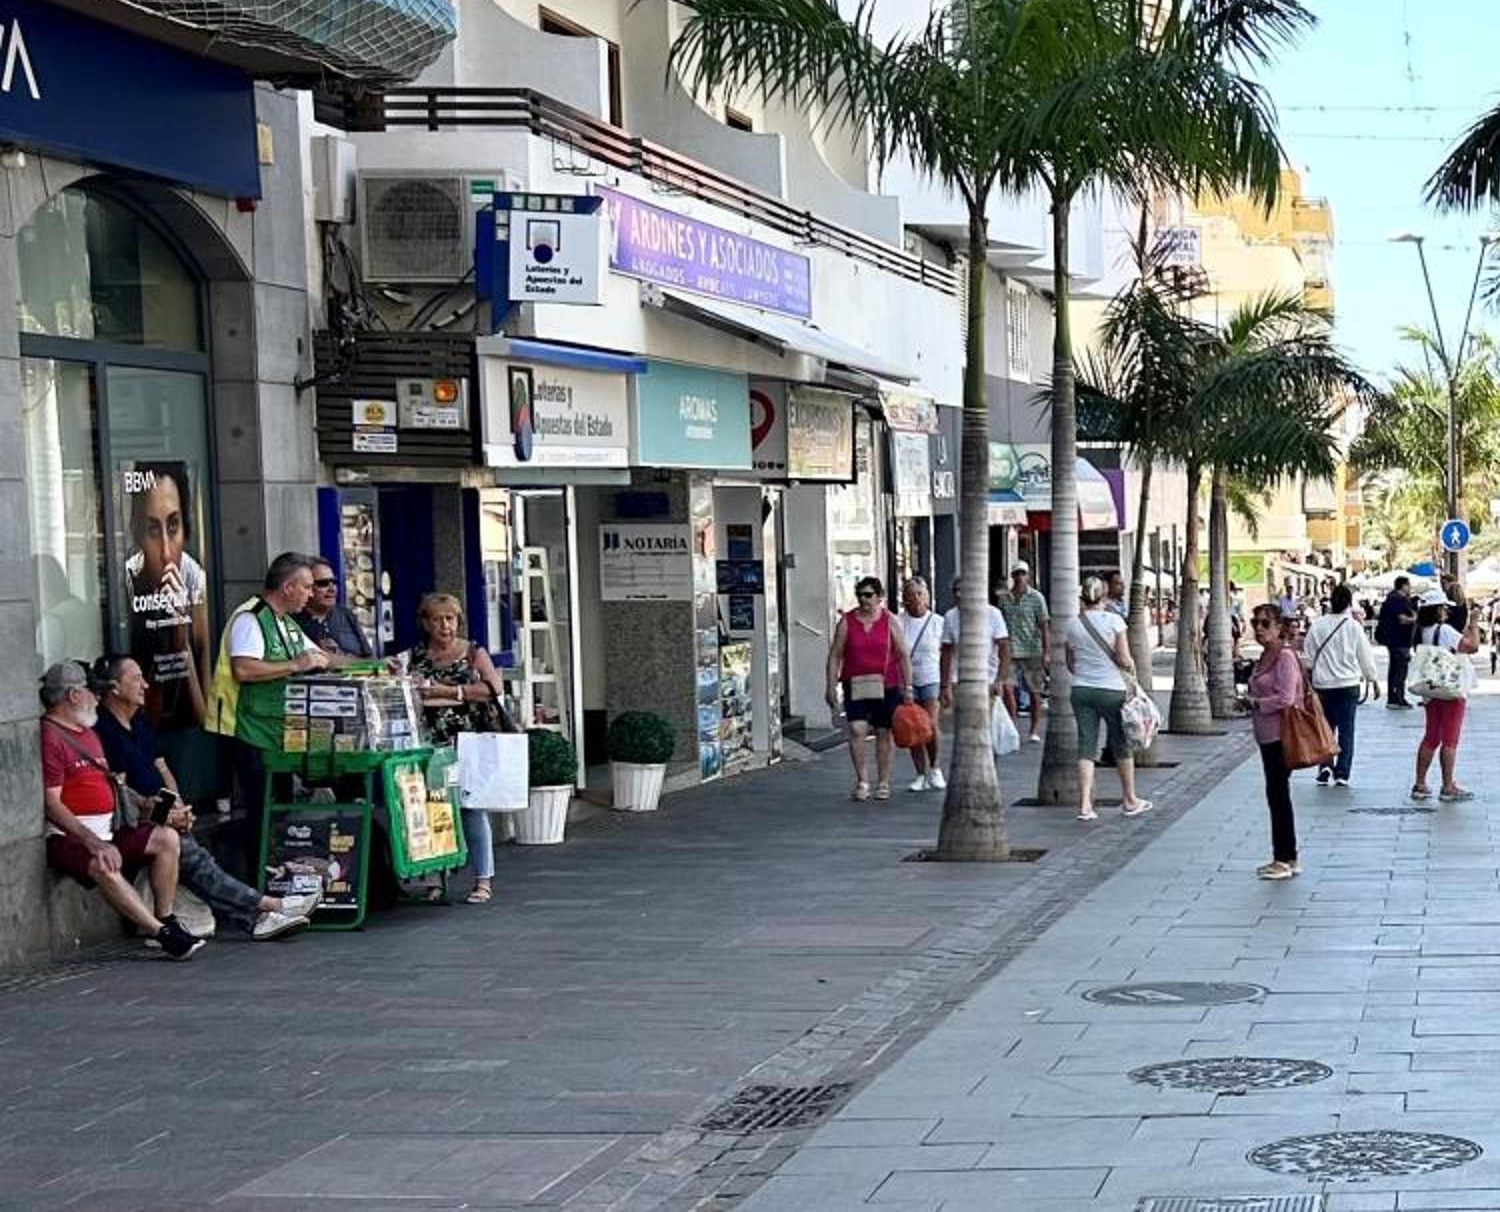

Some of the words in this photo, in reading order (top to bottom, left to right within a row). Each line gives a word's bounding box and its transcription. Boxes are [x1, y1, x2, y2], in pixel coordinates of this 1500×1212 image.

[630, 206, 695, 263] ARDINES
[711, 234, 779, 284] ASOCIADOS
[587, 413, 613, 436] Estado
[124, 470, 157, 493] BBVA
